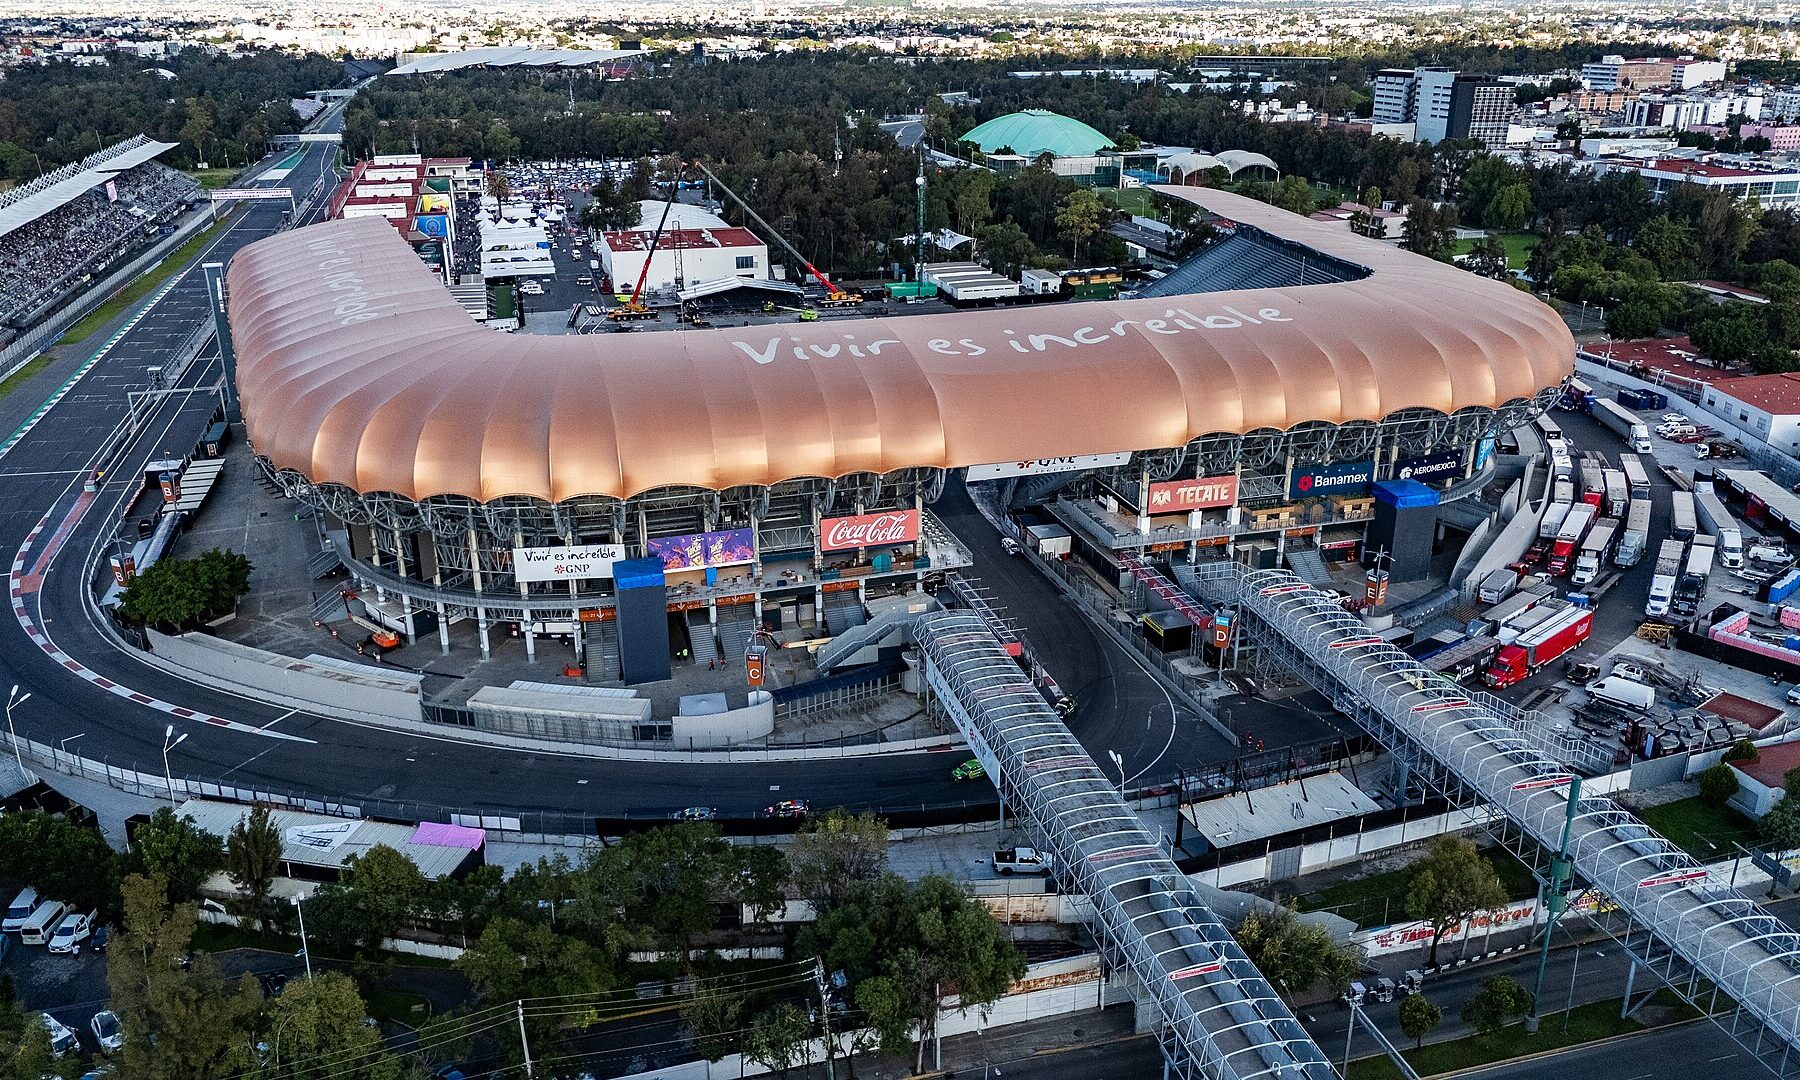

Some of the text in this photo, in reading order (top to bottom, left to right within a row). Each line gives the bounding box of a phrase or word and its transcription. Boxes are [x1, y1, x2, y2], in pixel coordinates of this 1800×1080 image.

[732, 306, 1294, 364] Vivir es increíble
[1413, 460, 1457, 476] AEROMEXICO
[1314, 472, 1368, 488] Banamex
[163, 487, 172, 497] B
[1176, 483, 1231, 504] TECATE
[828, 513, 910, 547] Coca-Cola
[524, 551, 551, 563] Vivir
[567, 547, 617, 561] increíble
[565, 564, 591, 574] GNP
[114, 571, 124, 582] B
[1367, 587, 1376, 599] E
[1379, 587, 1386, 599] E
[1216, 630, 1227, 642] D
[749, 668, 761, 679] C
